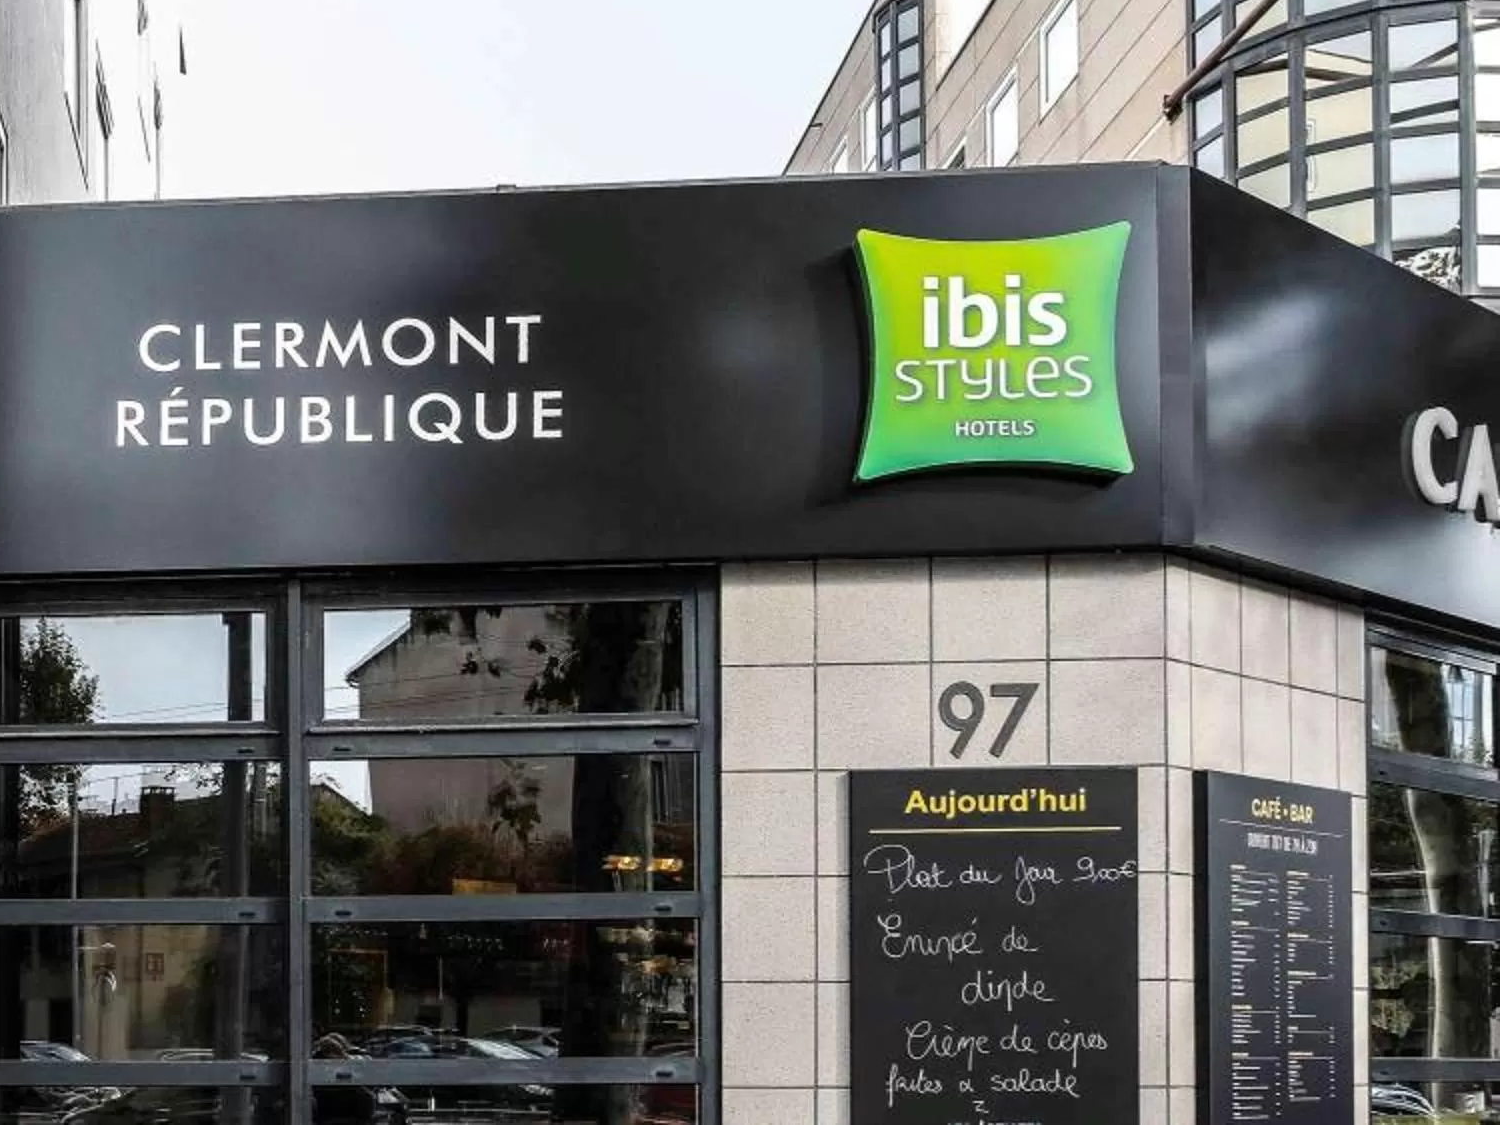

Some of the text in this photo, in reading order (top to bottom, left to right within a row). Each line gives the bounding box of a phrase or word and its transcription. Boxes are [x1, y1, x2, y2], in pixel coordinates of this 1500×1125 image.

[923, 274, 1068, 349] ibis
[138, 314, 543, 373] CLERMONT
[116, 386, 564, 447] RÉPUBLIQUE
[955, 419, 1036, 437] HOTELS
[938, 680, 1040, 760] 97
[904, 786, 1088, 820] Aujourd'hui
[1251, 796, 1314, 824] CAFÉ BAR
[864, 843, 953, 895] Plat
[959, 864, 1002, 884] du
[1002, 925, 1042, 953] de
[961, 969, 1055, 1012] dinde
[1000, 1023, 1039, 1054] de
[990, 1067, 1082, 1099] salade
